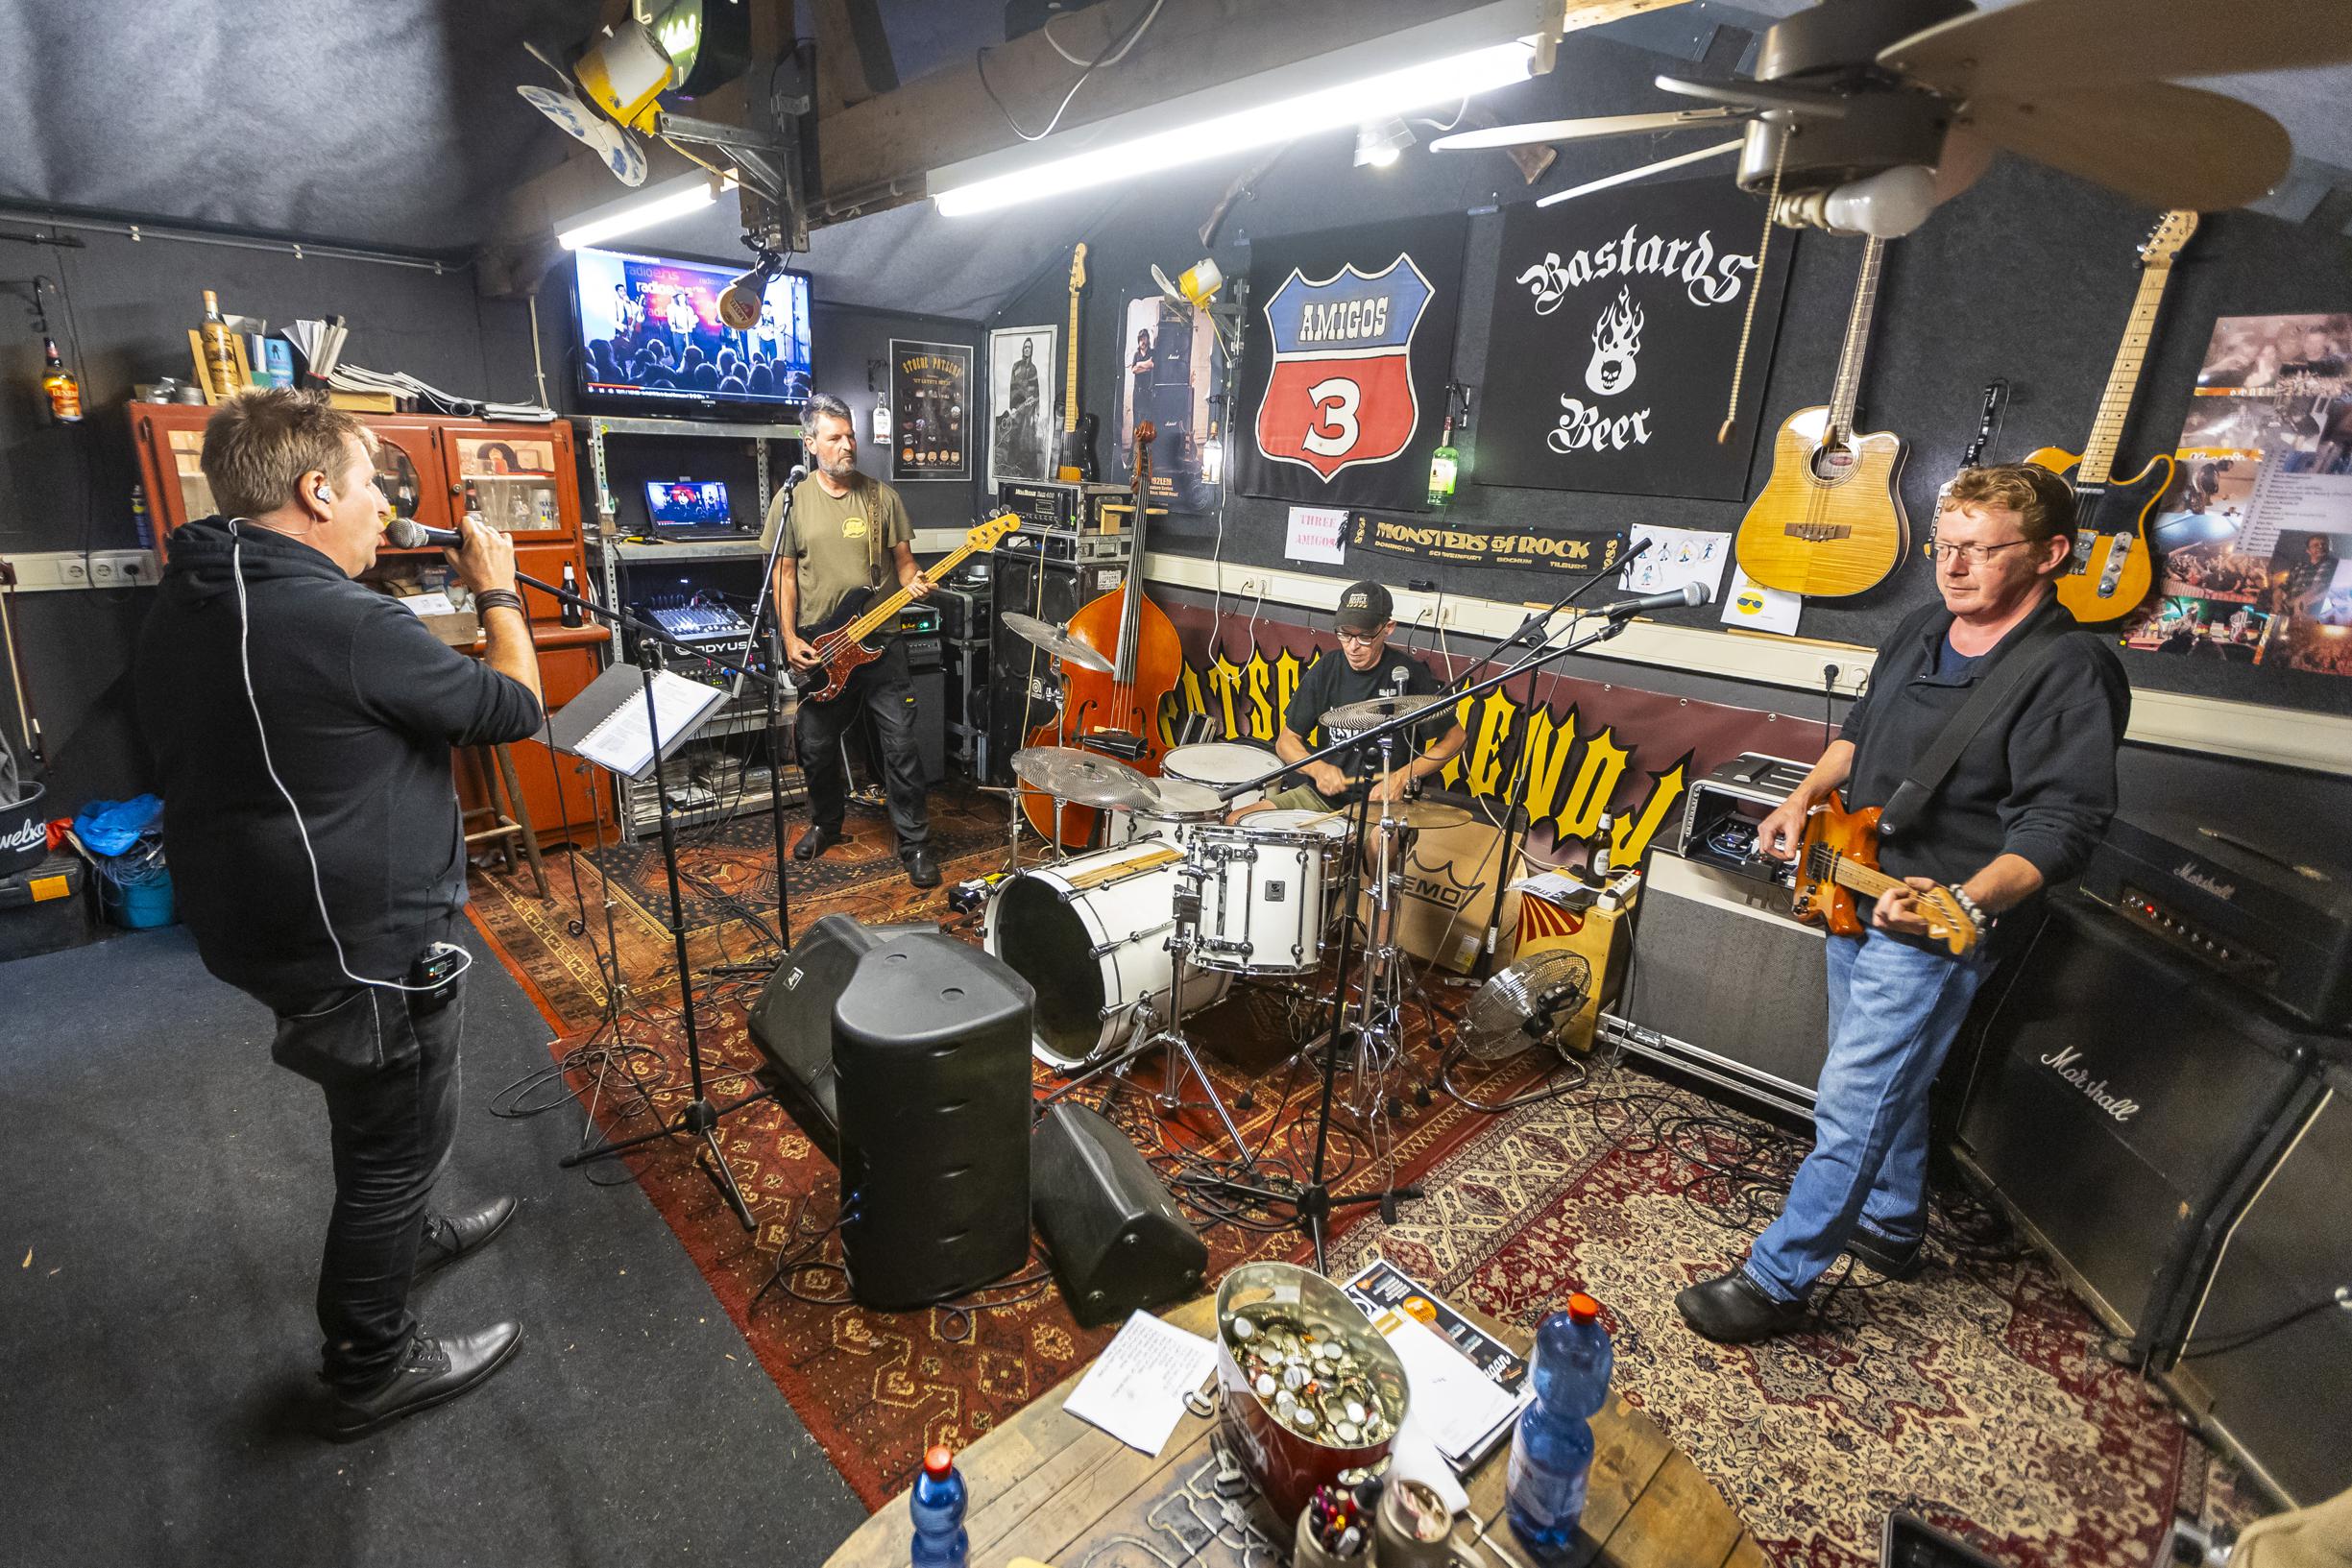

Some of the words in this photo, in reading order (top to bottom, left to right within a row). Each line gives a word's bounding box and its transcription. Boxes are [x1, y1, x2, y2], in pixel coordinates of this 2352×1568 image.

[1515, 224, 1759, 316] Bastards
[1298, 296, 1389, 342] AMIGOS
[1301, 376, 1361, 457] 3
[1547, 393, 1652, 453] Beer
[1374, 540, 1416, 553] DONINGTON
[1376, 521, 1491, 552] MONSTERS
[1491, 535, 1516, 554] of
[1515, 536, 1591, 560] ROCK
[1428, 549, 1483, 562] SCHWEINFURT
[1550, 561, 1588, 569] TILBURG
[2172, 861, 2236, 901] Marshall
[2040, 1046, 2140, 1122] Marshall
